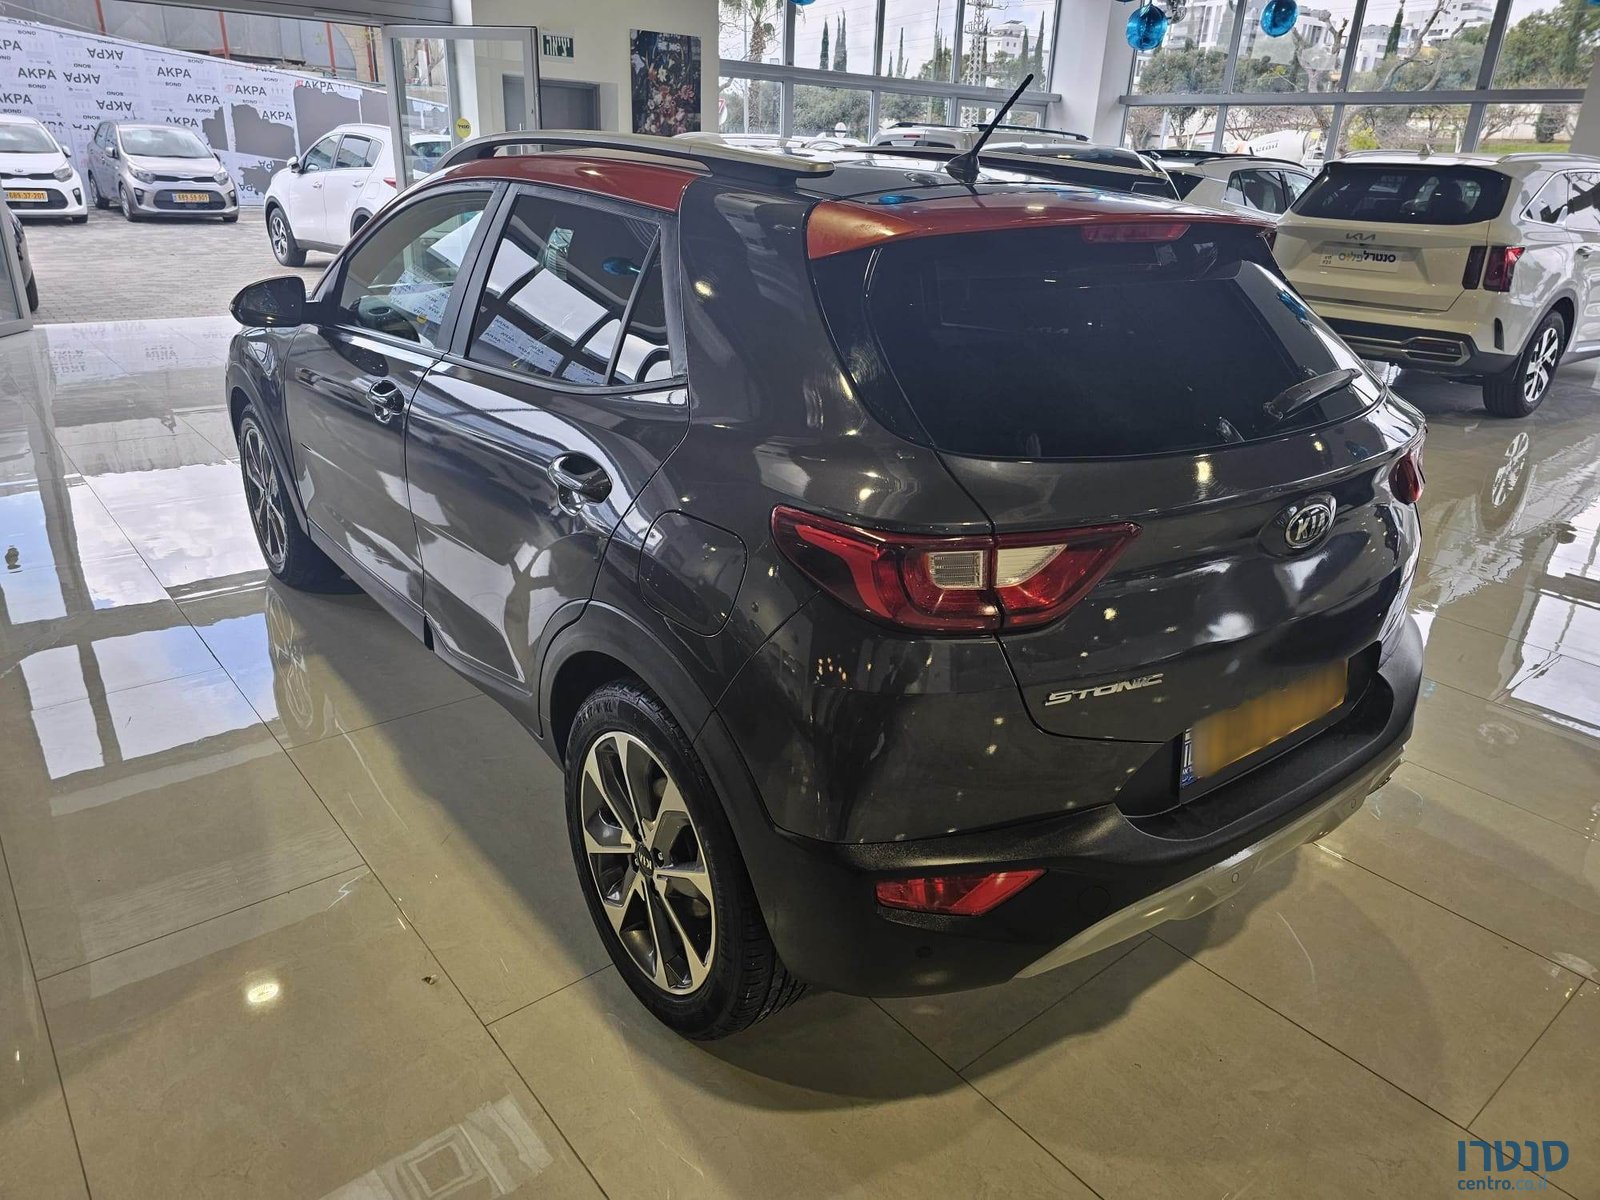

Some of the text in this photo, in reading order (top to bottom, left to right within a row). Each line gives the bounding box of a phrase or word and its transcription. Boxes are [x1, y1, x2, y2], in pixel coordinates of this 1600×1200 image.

[545, 36, 571, 57] יציאה
[87, 48, 124, 61] AKPA
[18, 67, 57, 80] AKPA
[63, 72, 101, 85] AKPA
[157, 66, 192, 79] AKPA
[234, 84, 267, 97] AKPA
[303, 80, 335, 91] AKPA
[186, 93, 220, 105] AKPA
[96, 100, 133, 112] AKPA
[261, 110, 293, 121] AKPA
[1044, 673, 1164, 707] STONIC
